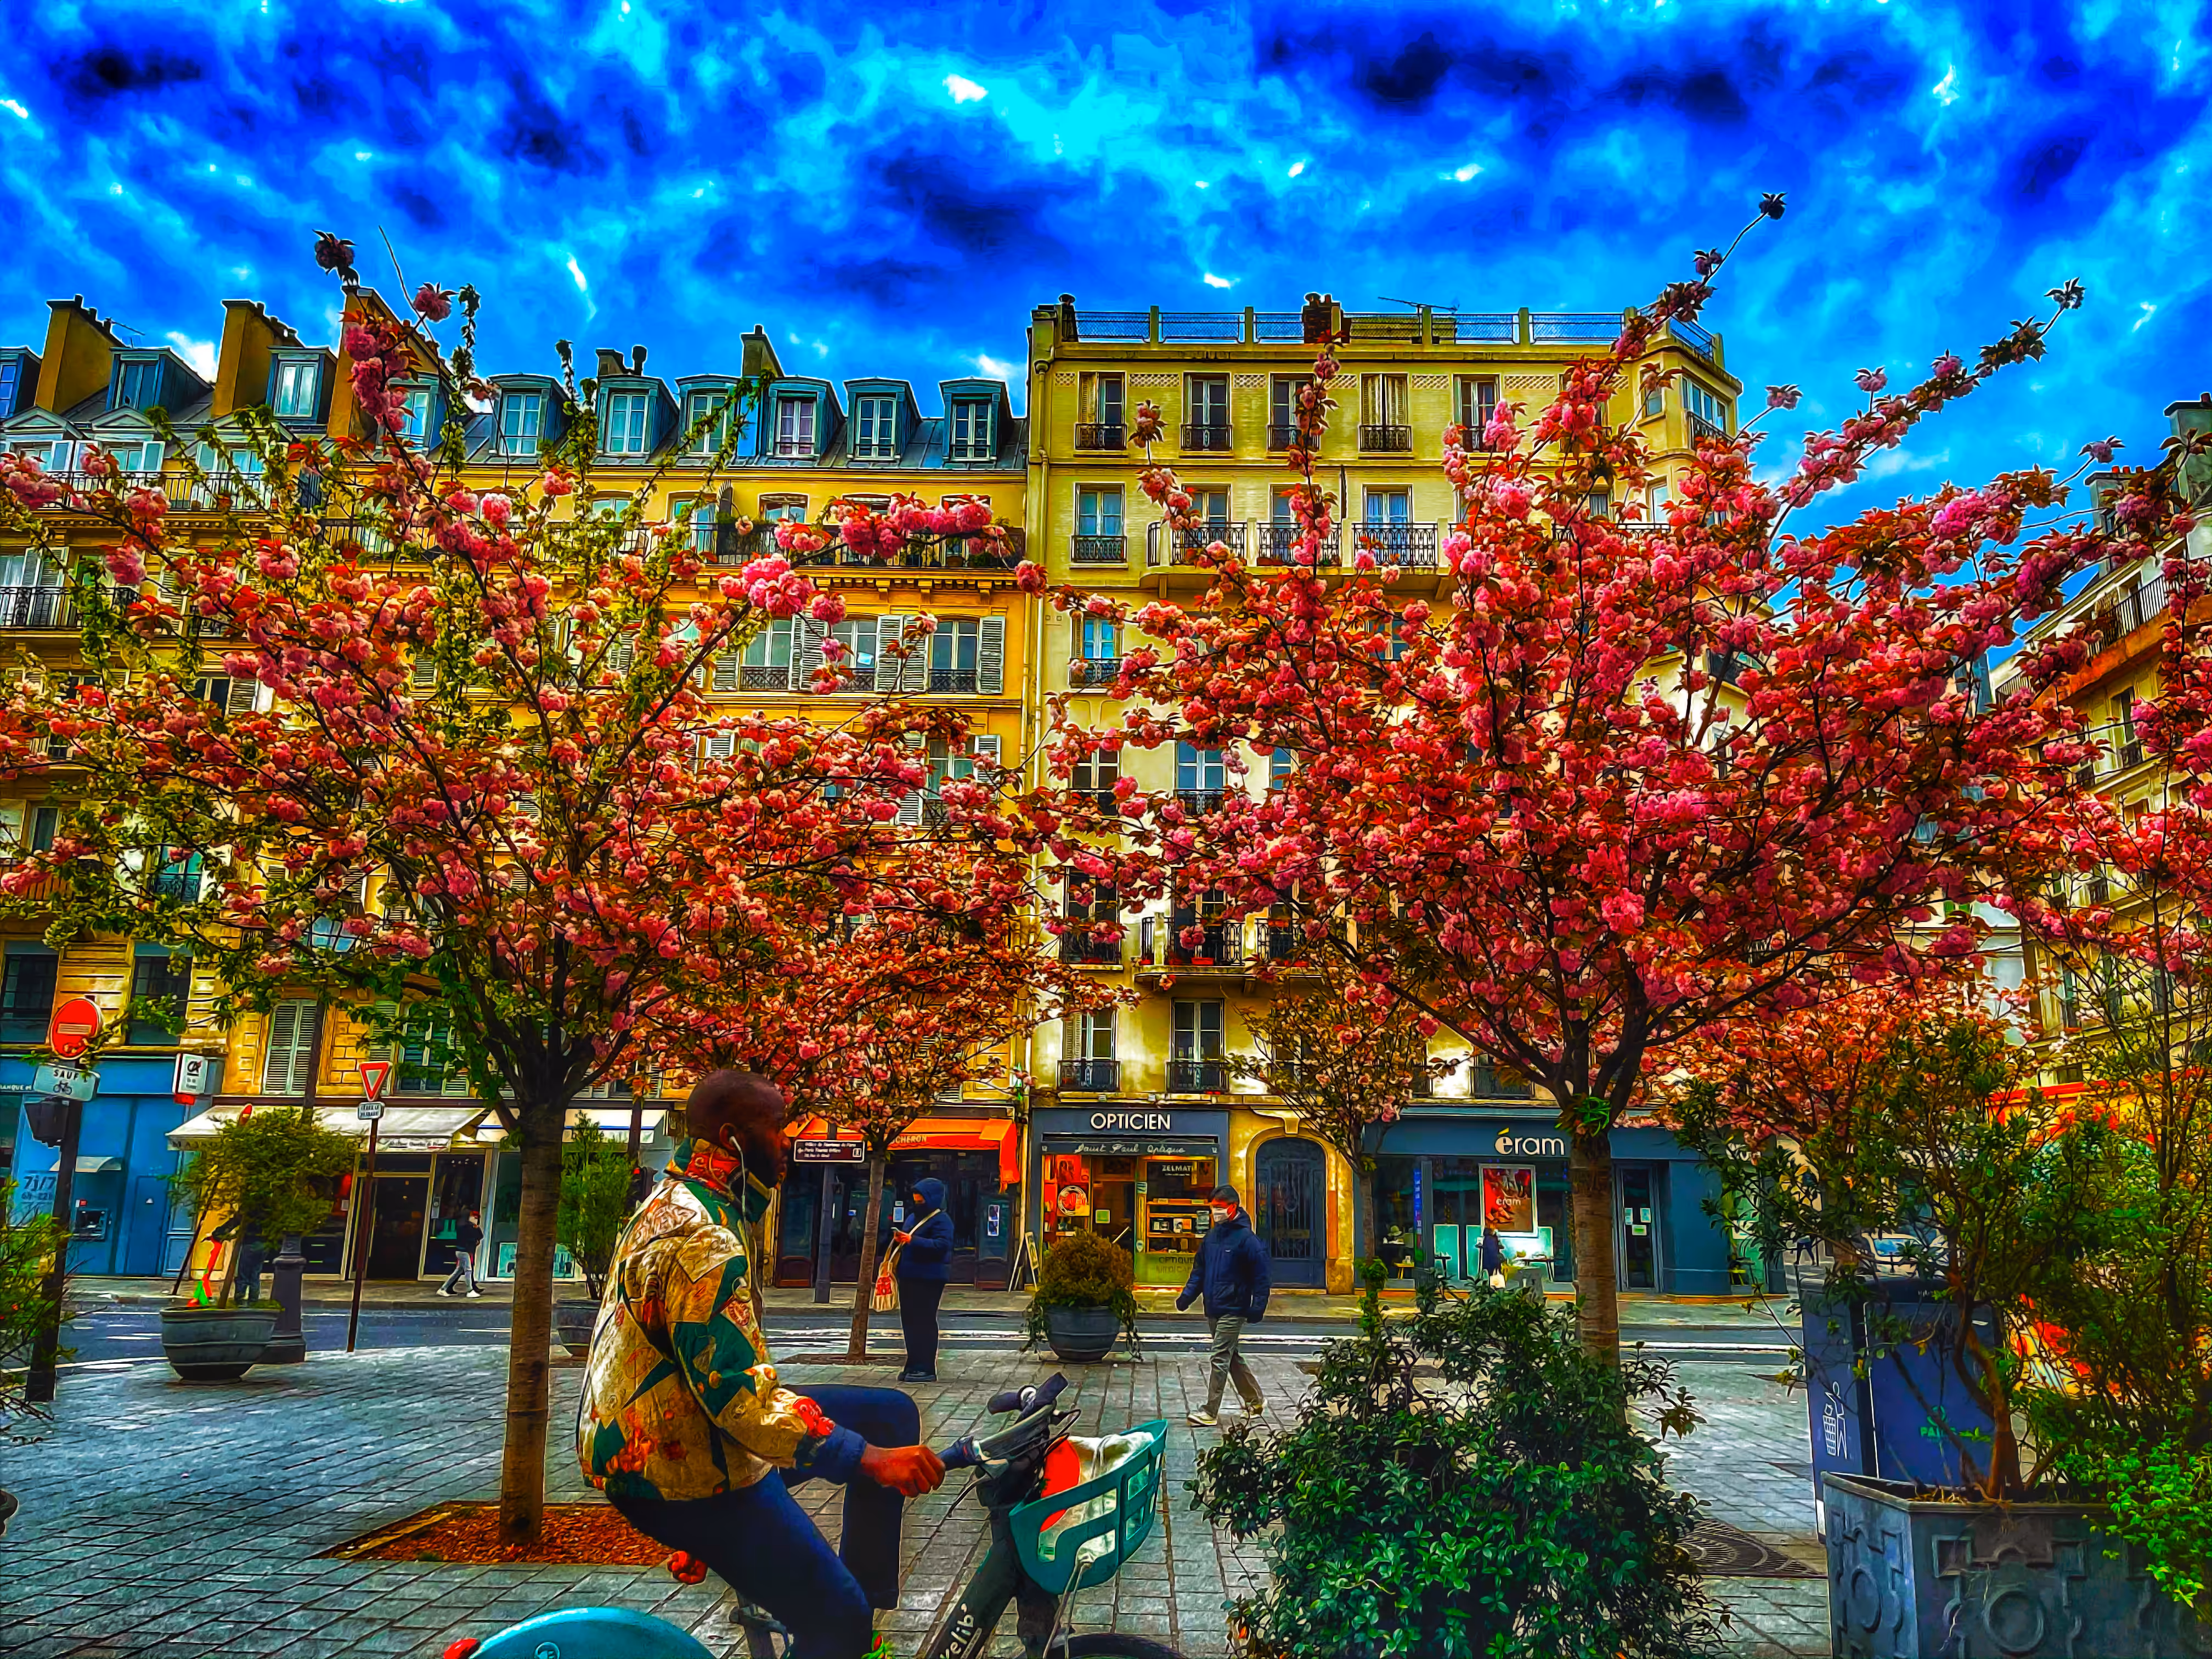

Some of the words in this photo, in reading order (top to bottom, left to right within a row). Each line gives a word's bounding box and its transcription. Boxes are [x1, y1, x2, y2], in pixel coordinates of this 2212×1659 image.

[53, 1069, 79, 1080] SAUF
[1091, 1113, 1170, 1130] OPTICIEN
[1075, 1143, 1106, 1154] Saint
[1110, 1143, 1139, 1154] Paul
[1147, 1144, 1186, 1154] Optique
[1495, 1127, 1565, 1155] éram
[24, 1175, 57, 1191] 7j/7
